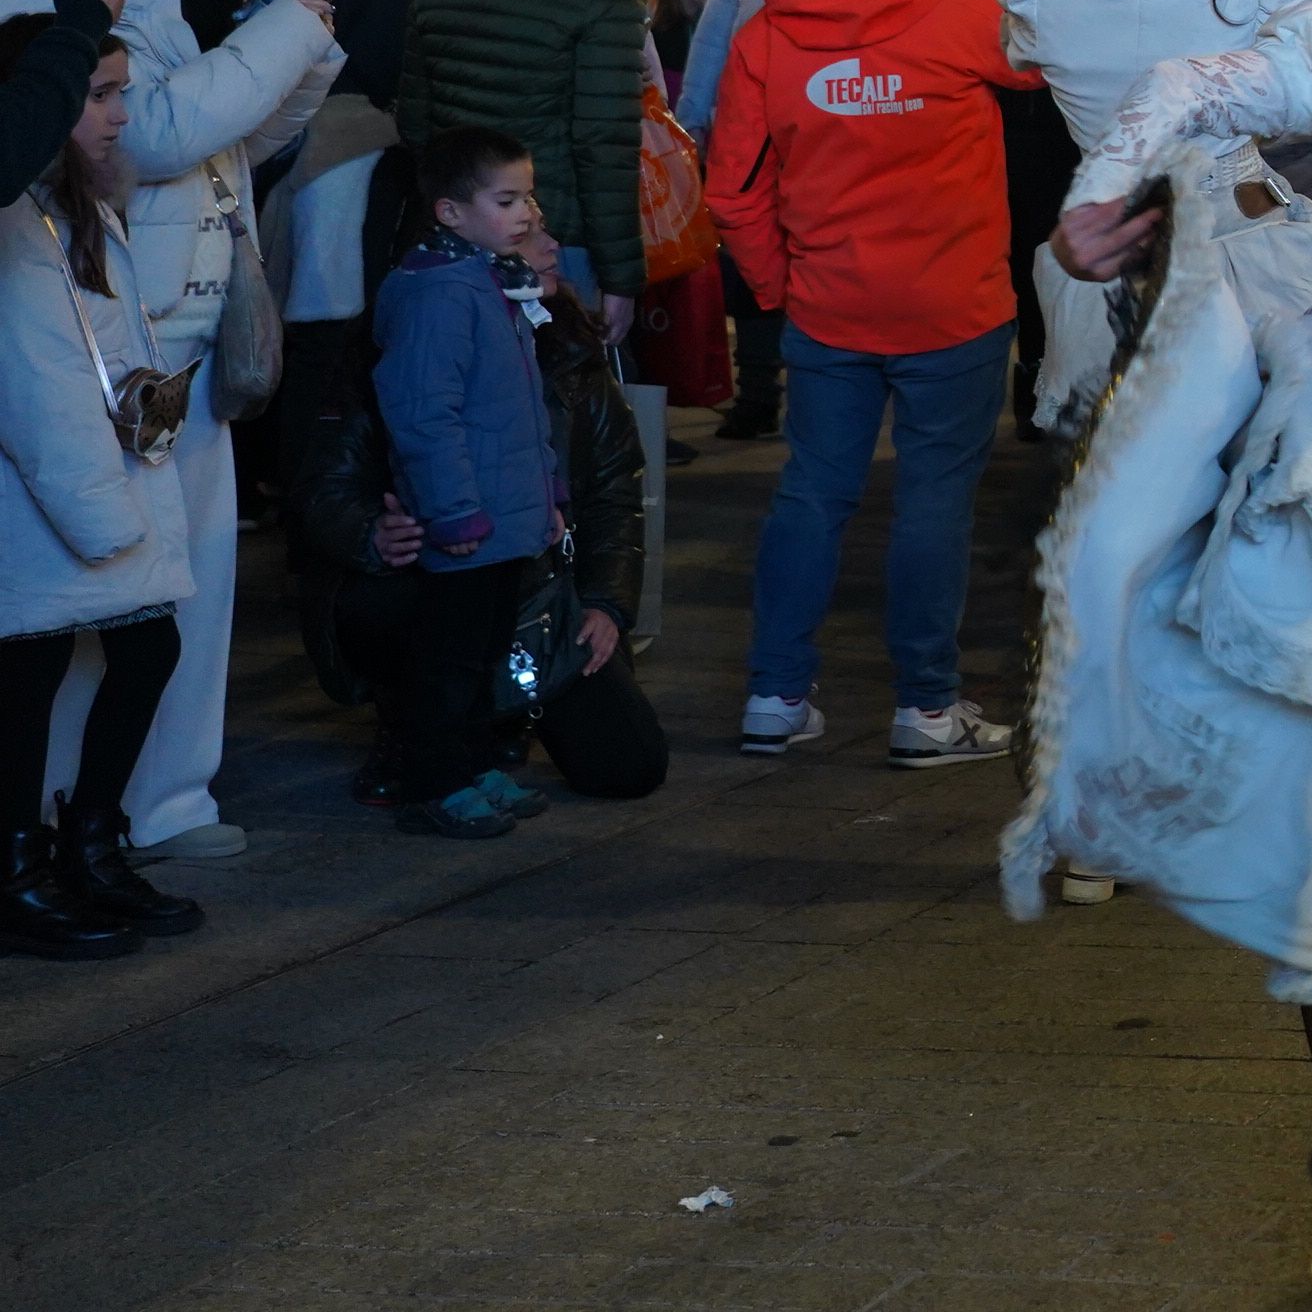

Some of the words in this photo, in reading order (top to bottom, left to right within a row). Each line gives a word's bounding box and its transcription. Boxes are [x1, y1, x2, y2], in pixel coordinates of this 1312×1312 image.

[825, 74, 902, 105] TECALP
[861, 101, 875, 115] ski
[876, 100, 903, 115] racing
[905, 98, 924, 112] team
